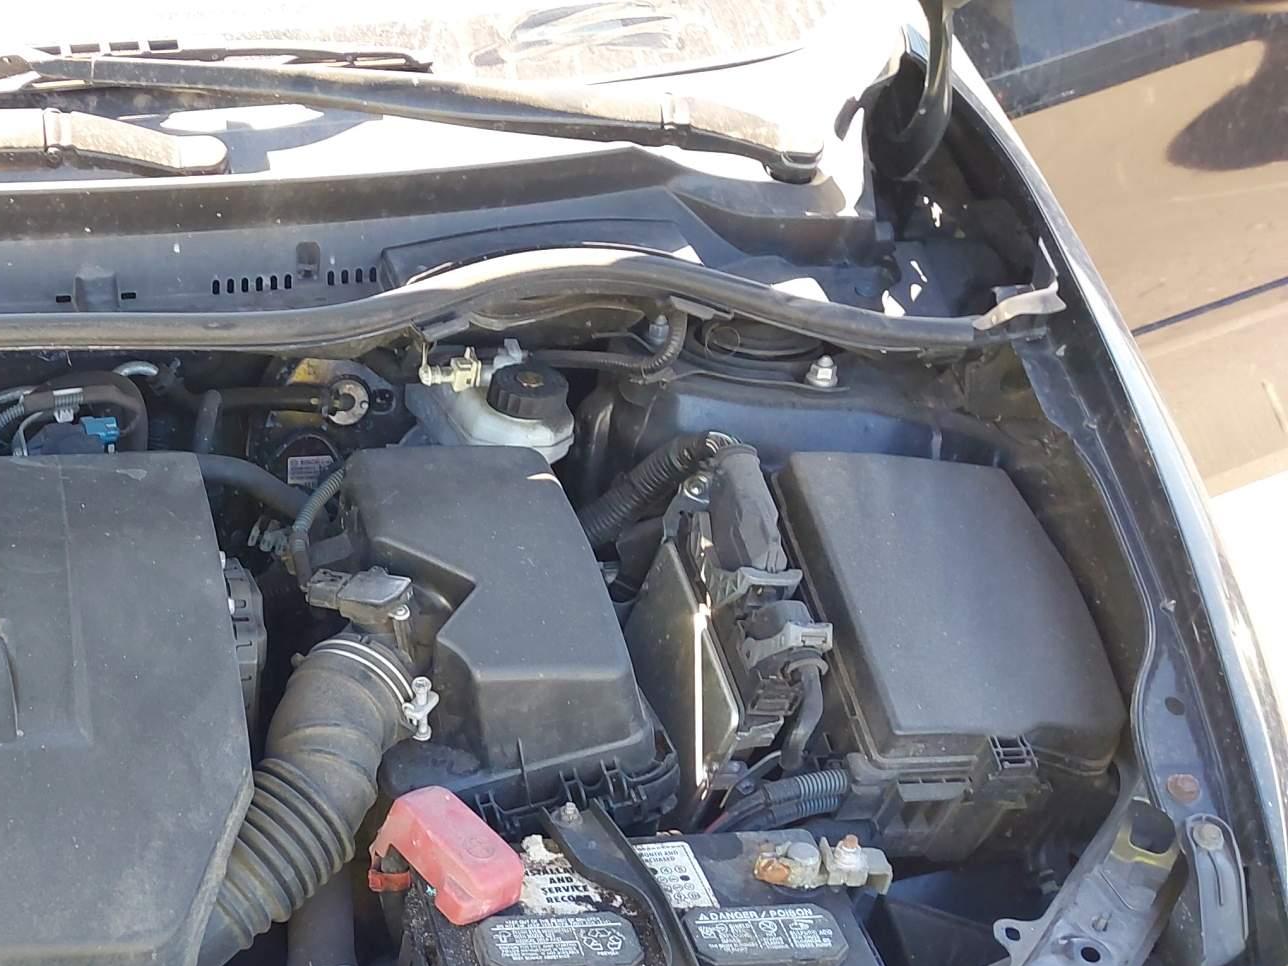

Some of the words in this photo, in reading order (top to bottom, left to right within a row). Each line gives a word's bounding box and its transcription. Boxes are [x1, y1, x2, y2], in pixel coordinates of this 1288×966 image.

[549, 876, 574, 885] AND
[540, 884, 590, 896] SERVICE
[710, 910, 757, 921] DANGER
[769, 908, 813, 918] POISON
